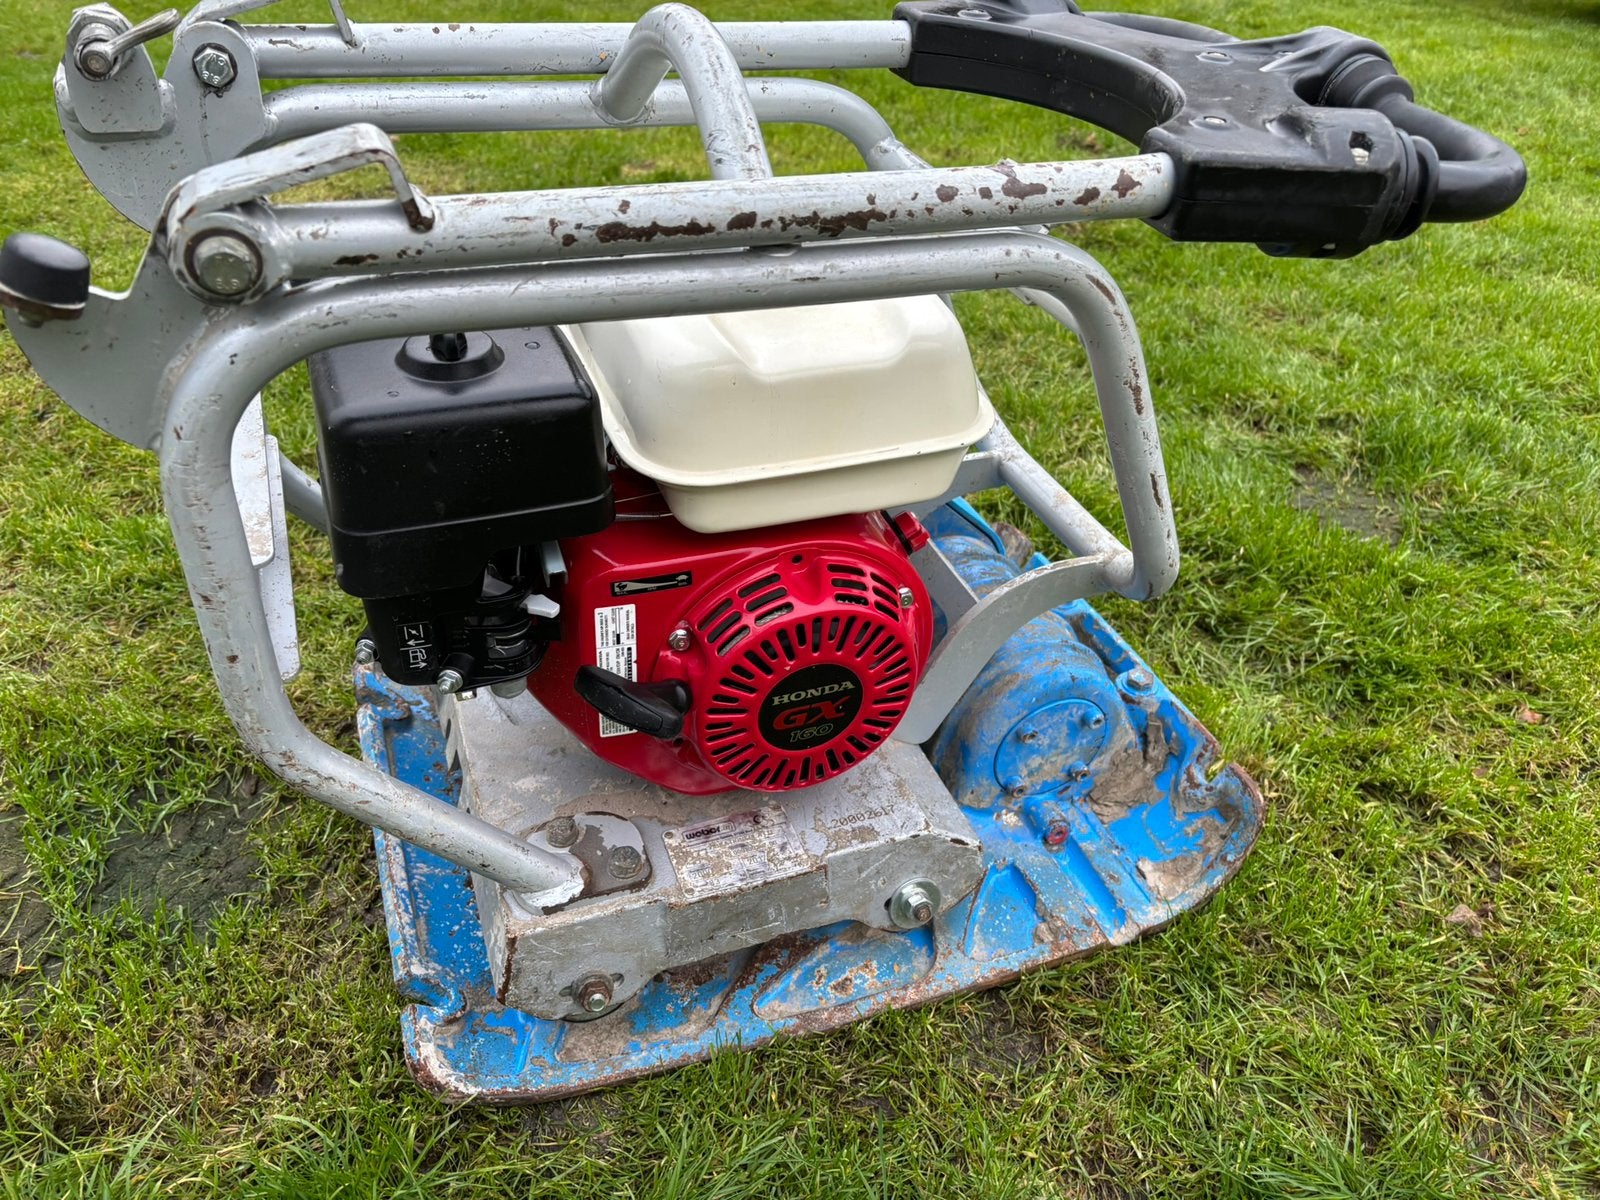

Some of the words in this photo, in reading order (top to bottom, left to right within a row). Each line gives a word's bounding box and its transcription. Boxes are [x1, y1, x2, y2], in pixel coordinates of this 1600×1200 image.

[772, 680, 856, 706] HONDA
[773, 695, 851, 731] GX
[790, 723, 834, 743] 160
[830, 804, 895, 829] 20002617
[685, 825, 721, 840] weber
